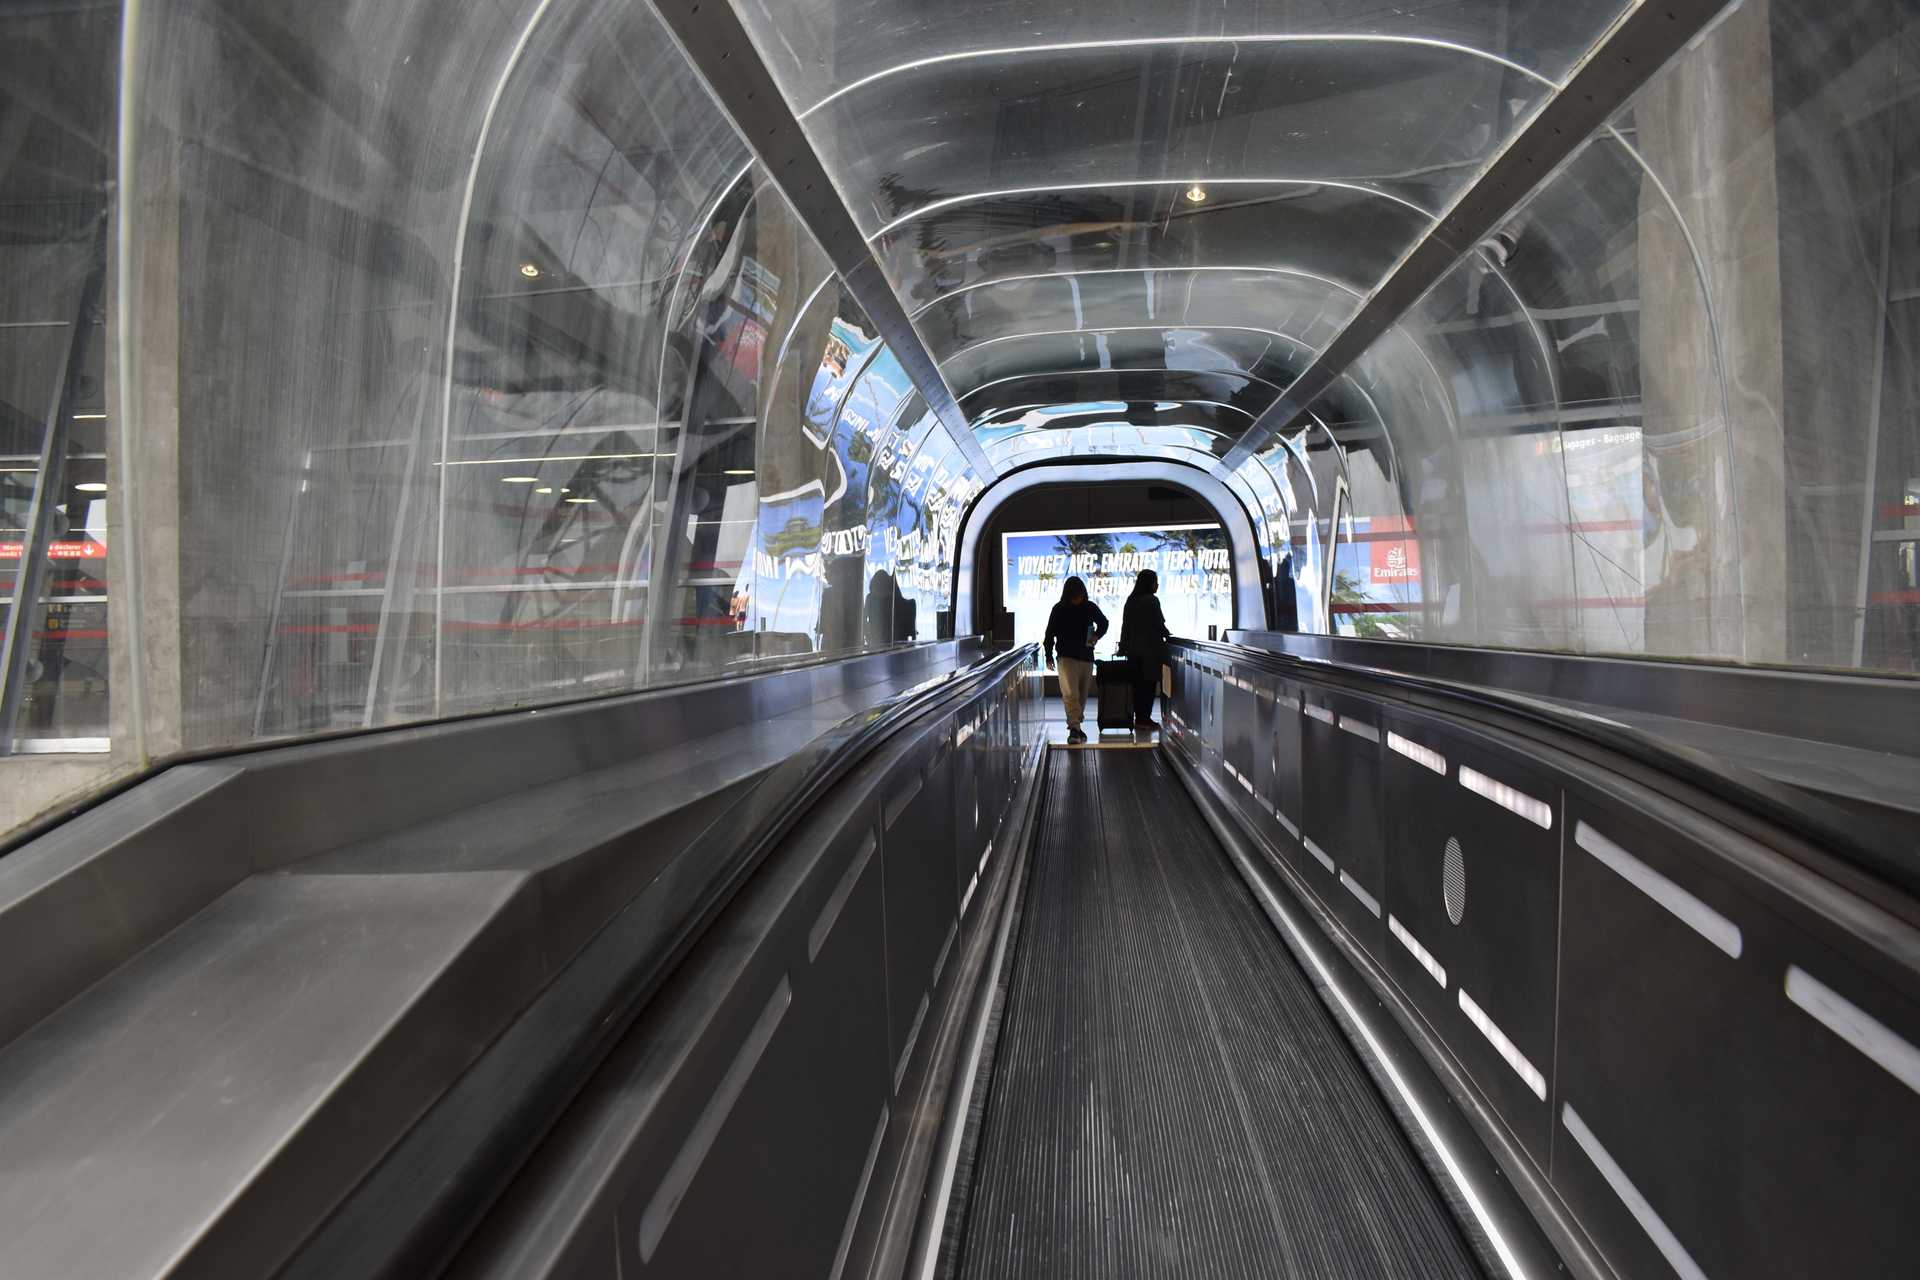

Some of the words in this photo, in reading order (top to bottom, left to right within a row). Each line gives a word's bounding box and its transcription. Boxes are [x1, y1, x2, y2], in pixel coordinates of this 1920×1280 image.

[1017, 554, 1066, 576] VOYAGEZ
[1068, 552, 1099, 574] AVEC
[1101, 551, 1160, 573] EMIRATES
[1162, 550, 1194, 571] VERS
[1197, 548, 1230, 570] VOTR
[1017, 578, 1067, 599] PROCHA
[1165, 575, 1200, 595] DANS
[1202, 573, 1231, 594] L'OC
